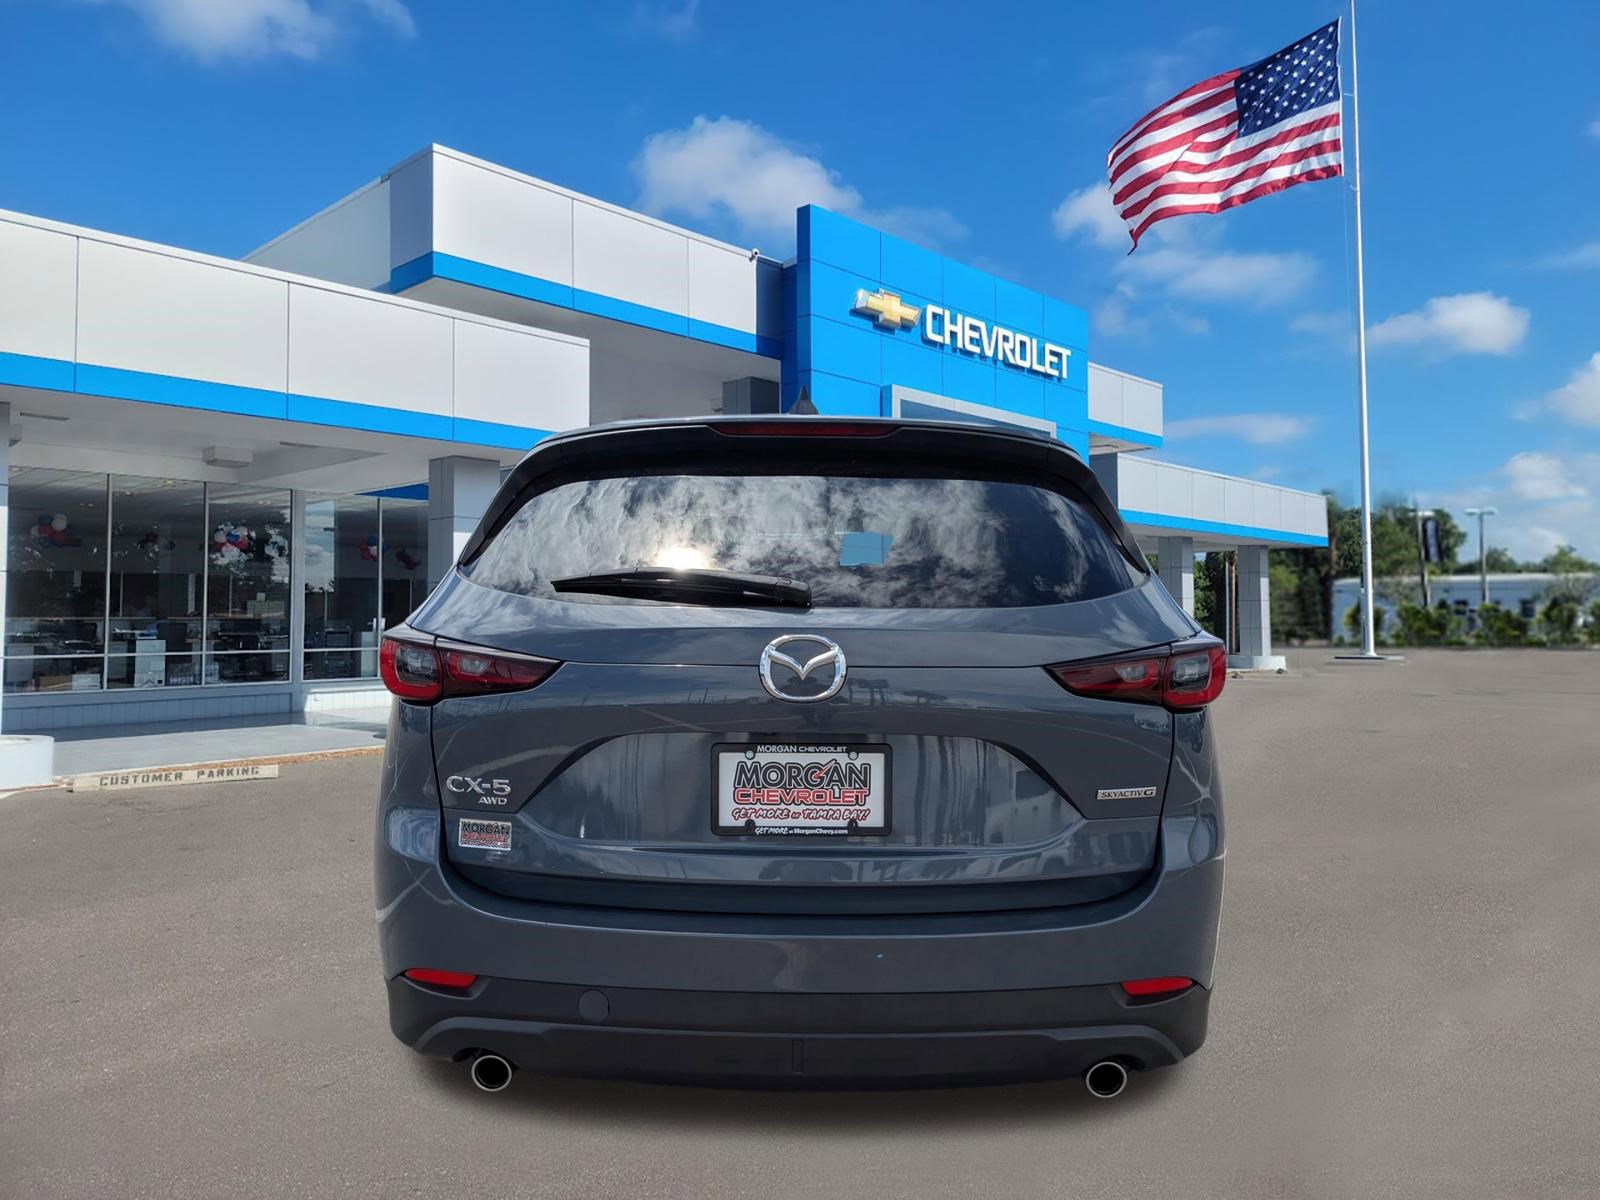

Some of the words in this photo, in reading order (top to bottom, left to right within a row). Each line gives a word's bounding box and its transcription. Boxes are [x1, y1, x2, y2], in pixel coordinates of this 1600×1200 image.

[925, 304, 1071, 378] CHEVROLET
[757, 745, 797, 753] MORGAN
[99, 772, 183, 787] CUSTOMER
[197, 766, 259, 779] PARKING
[734, 759, 871, 789] MORGAN
[446, 775, 511, 795] CX-5
[478, 796, 508, 805] AWD
[734, 788, 869, 806] CHEVROLET
[732, 808, 756, 821] GET
[757, 808, 789, 819] MORE
[802, 808, 841, 820] TAMPA
